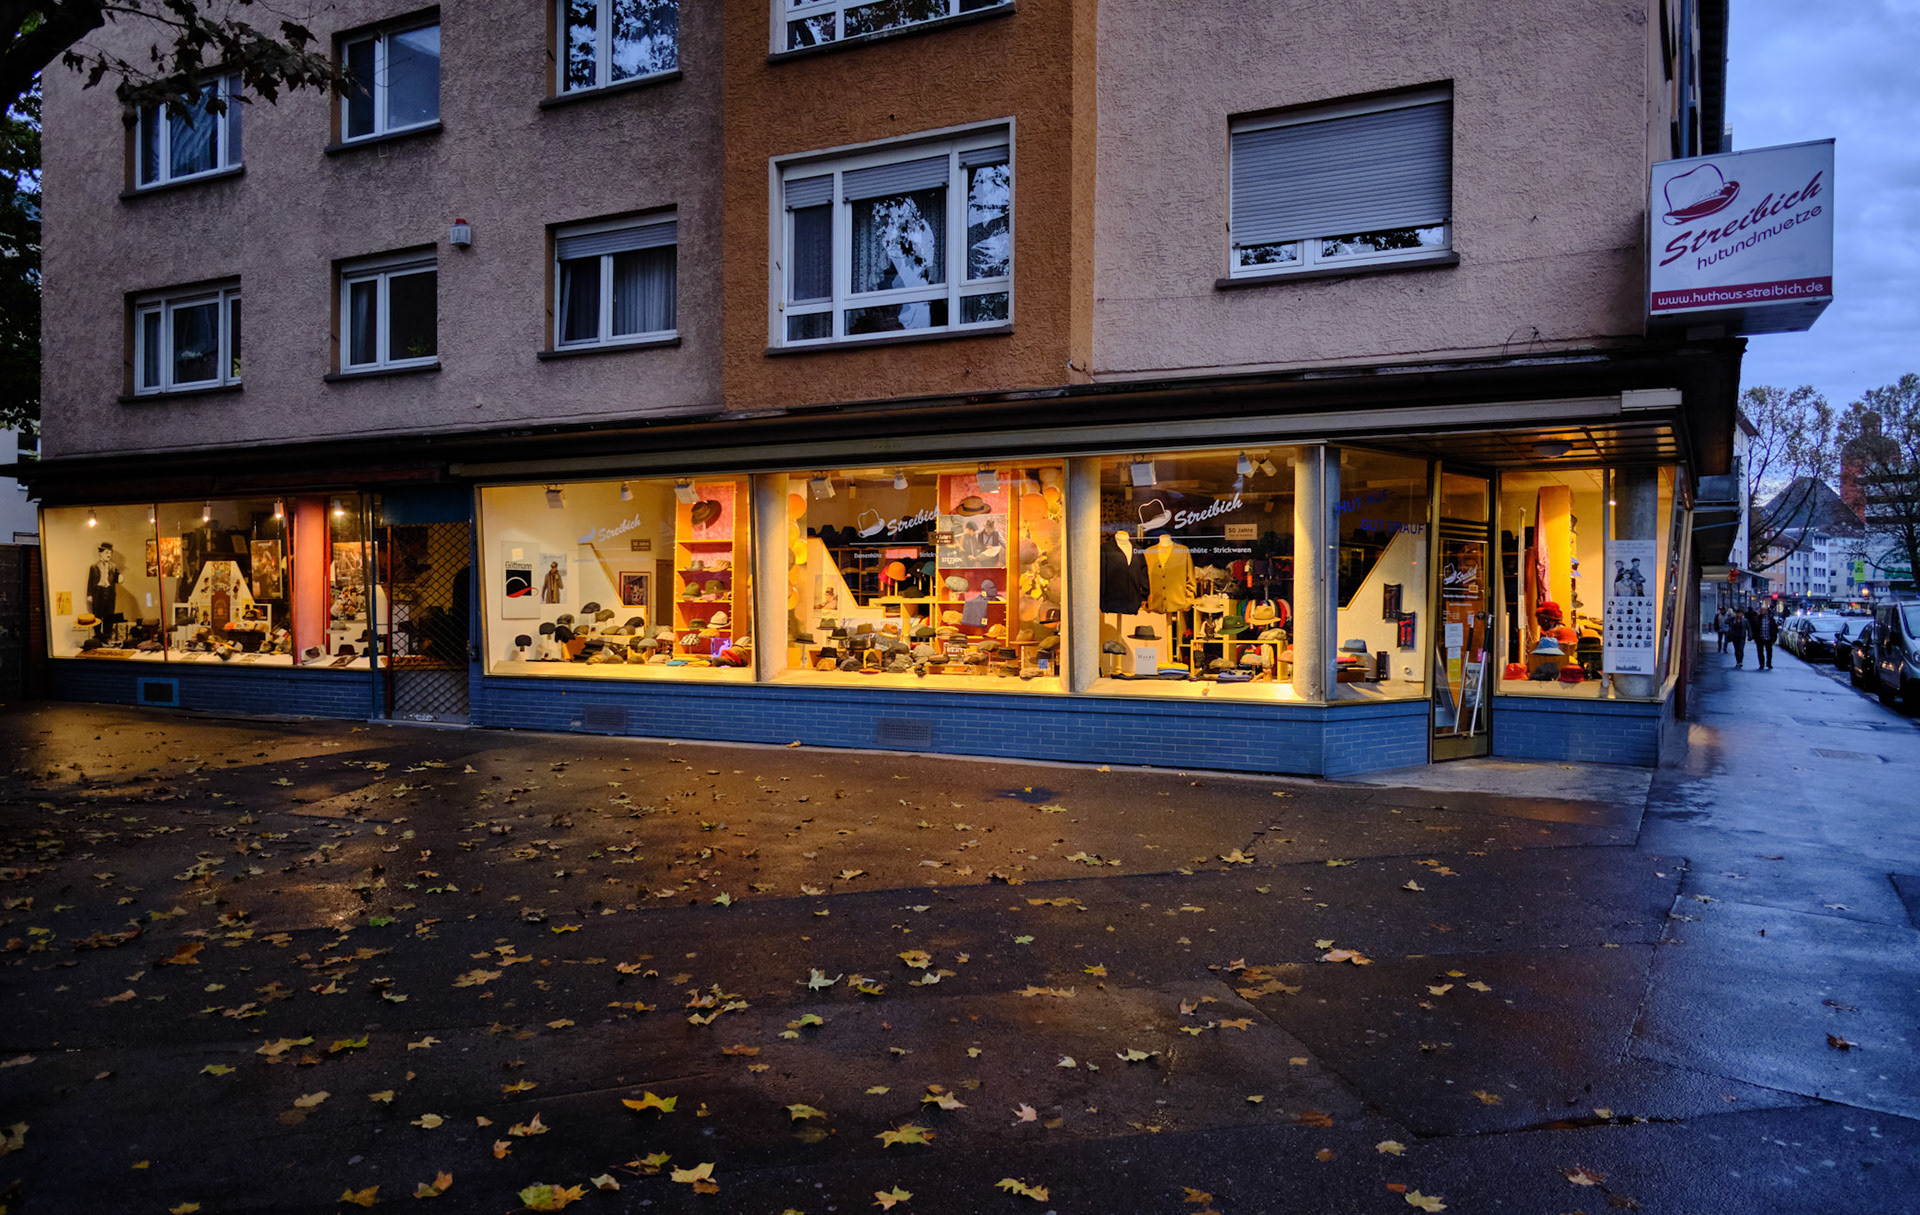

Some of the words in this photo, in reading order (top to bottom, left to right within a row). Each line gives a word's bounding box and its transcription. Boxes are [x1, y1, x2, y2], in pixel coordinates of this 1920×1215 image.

[1659, 170, 1823, 266] Streibich
[1697, 205, 1822, 270] hutundmuetze
[1658, 282, 1824, 306] www.huthaus-streibich.de
[887, 504, 940, 536] Streibich
[1174, 492, 1243, 529] Streibich
[1337, 497, 1361, 514] HUT
[598, 513, 641, 543] Streibich
[1361, 518, 1384, 531] GUT
[1387, 521, 1424, 534] DRAUF
